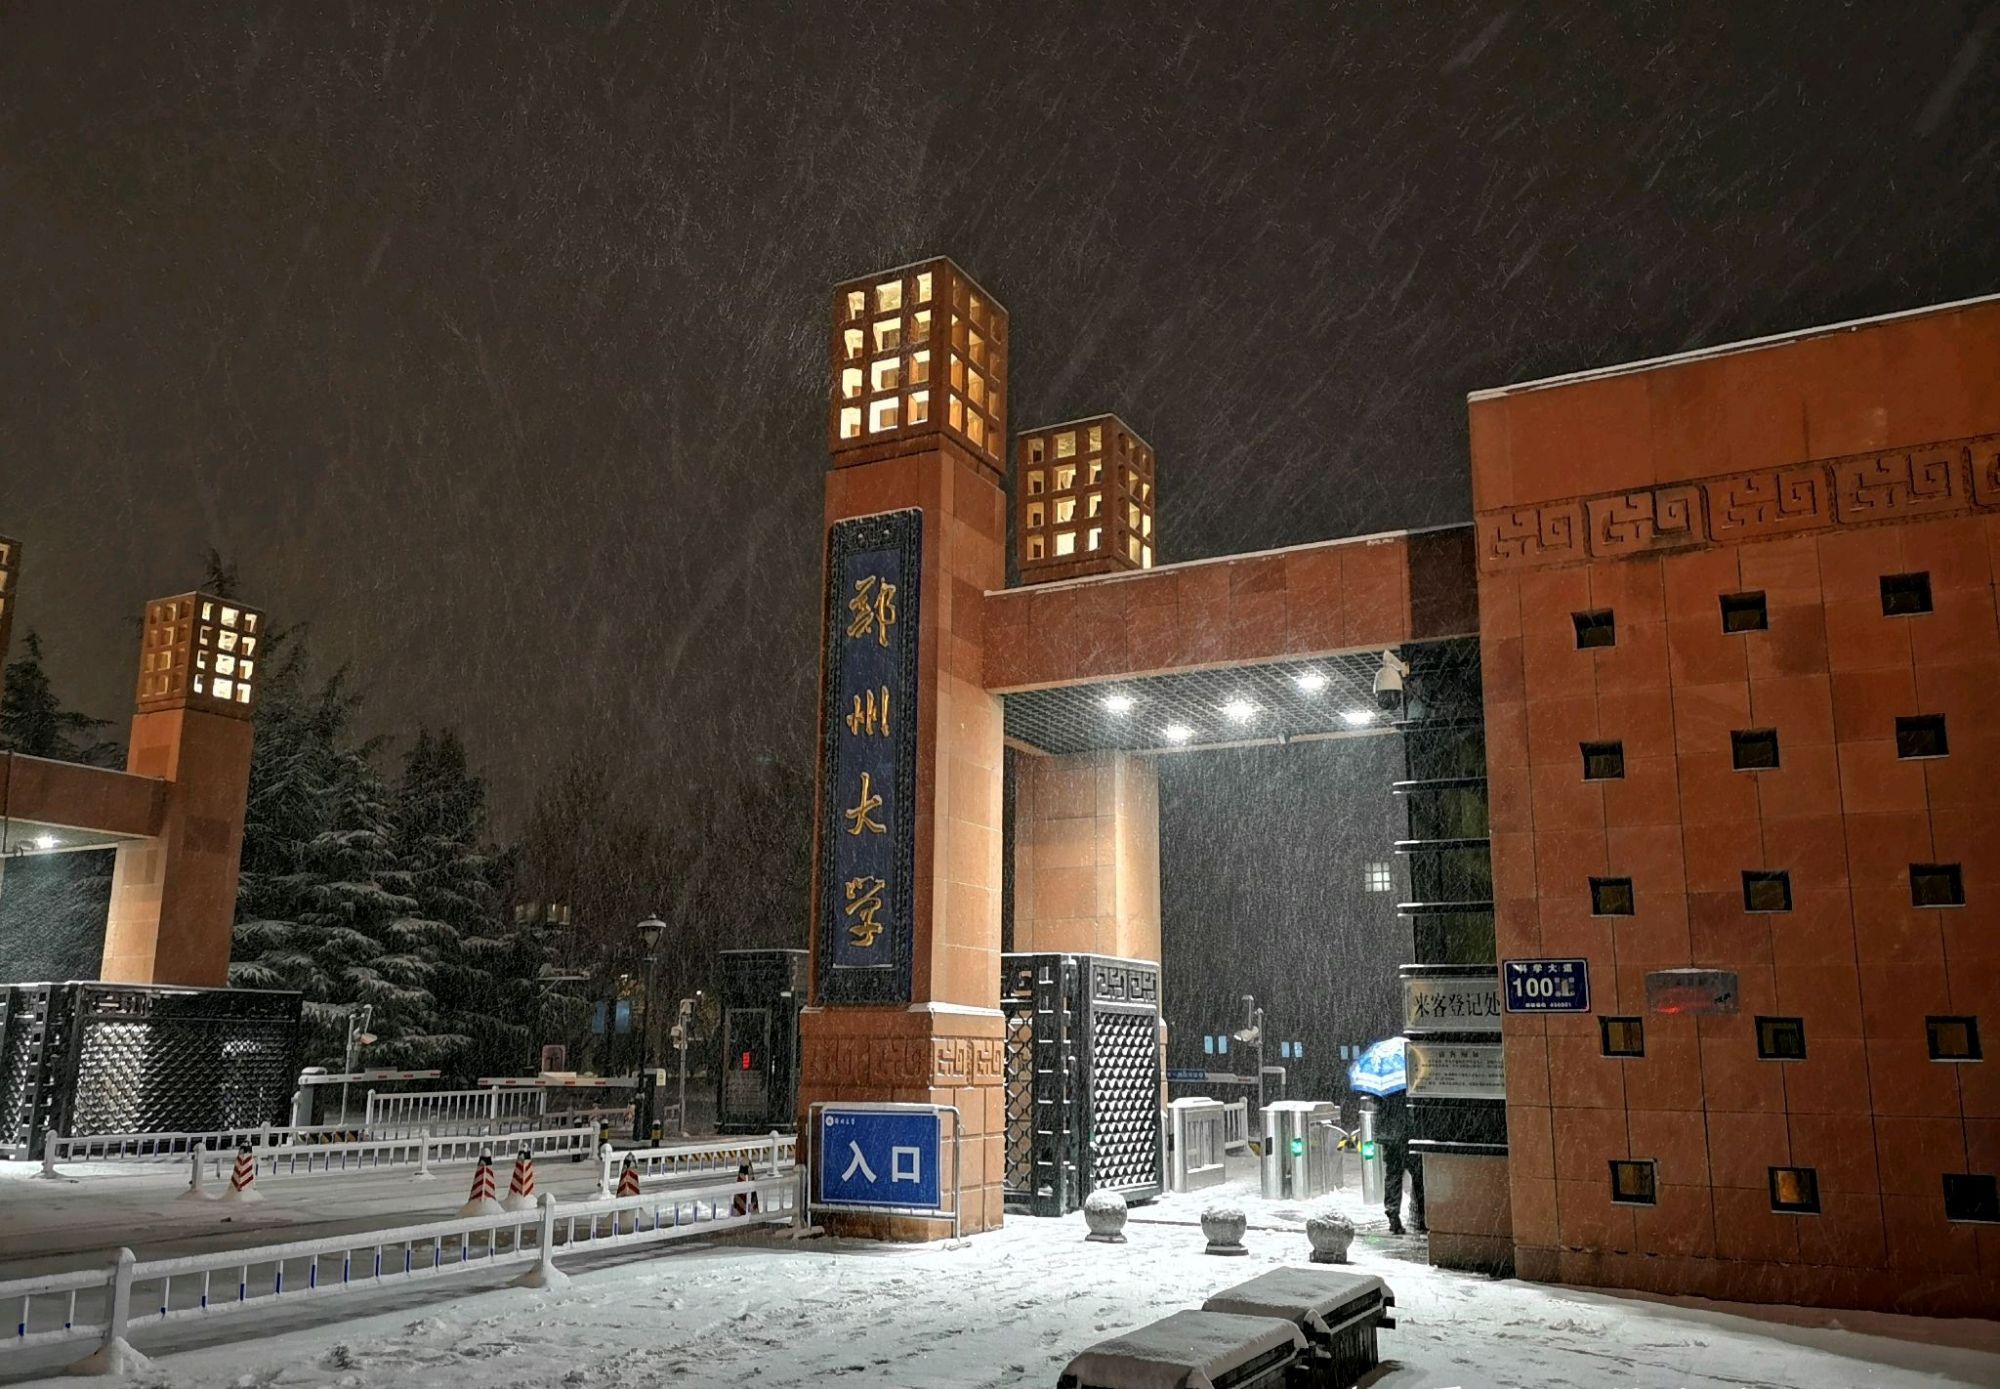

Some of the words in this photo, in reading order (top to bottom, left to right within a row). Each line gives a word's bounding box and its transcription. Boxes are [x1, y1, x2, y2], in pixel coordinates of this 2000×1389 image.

[845, 575, 898, 948] 郑州大学
[1414, 991, 1501, 1018] 来客登记处
[841, 1140, 920, 1184] 入口
